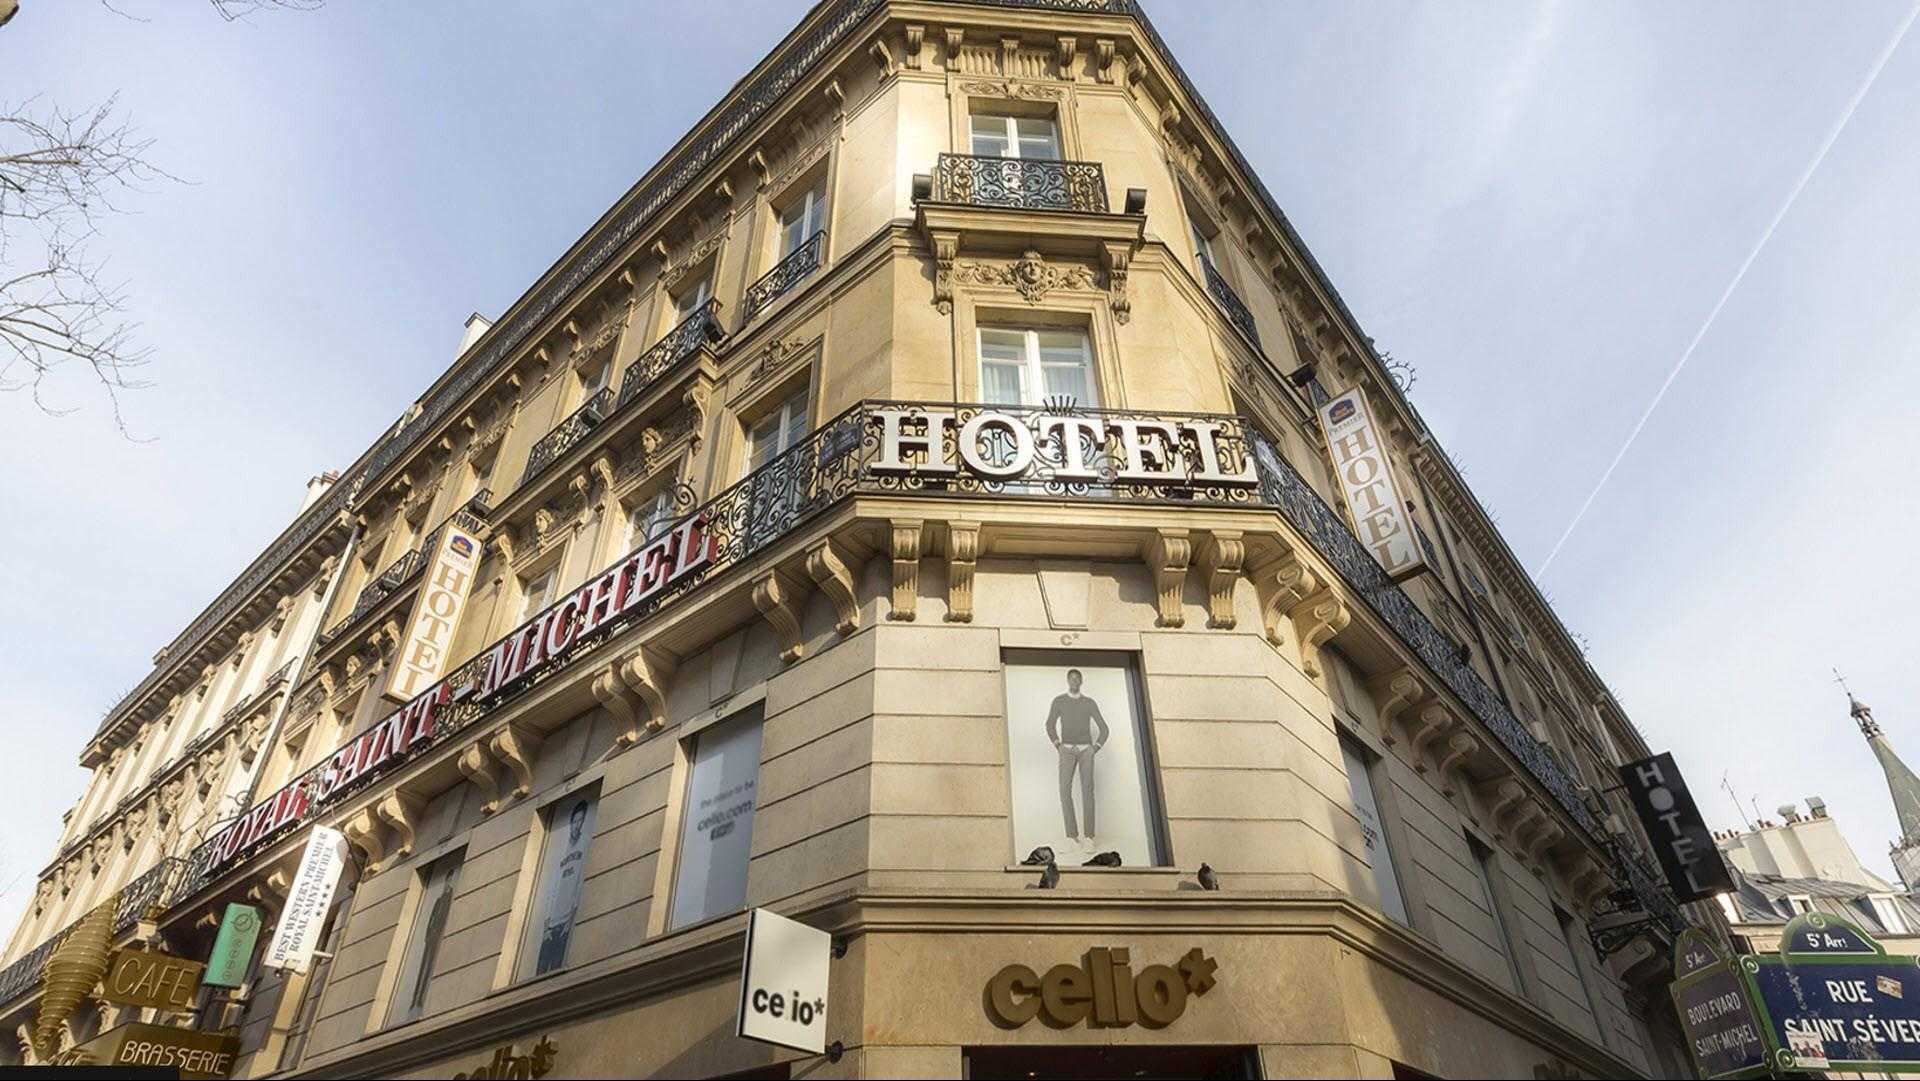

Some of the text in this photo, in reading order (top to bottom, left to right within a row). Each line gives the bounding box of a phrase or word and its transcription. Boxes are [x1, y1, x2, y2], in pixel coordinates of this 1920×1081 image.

[871, 411, 1259, 486] HOTEL
[1334, 426, 1411, 573] HOTEL
[200, 777, 310, 877] ROYAL
[1636, 762, 1713, 894] HOTEL
[274, 832, 328, 961] BEST WESTERN PREMIER
[289, 919, 309, 953] ROYAL
[115, 957, 194, 1005] CAFE
[1825, 980, 1874, 1003] RUE
[1687, 992, 1741, 1026] BOULEVARD
[120, 1040, 230, 1075] BRASSERIE
[1695, 1023, 1758, 1057] SAINT-MICHEL
